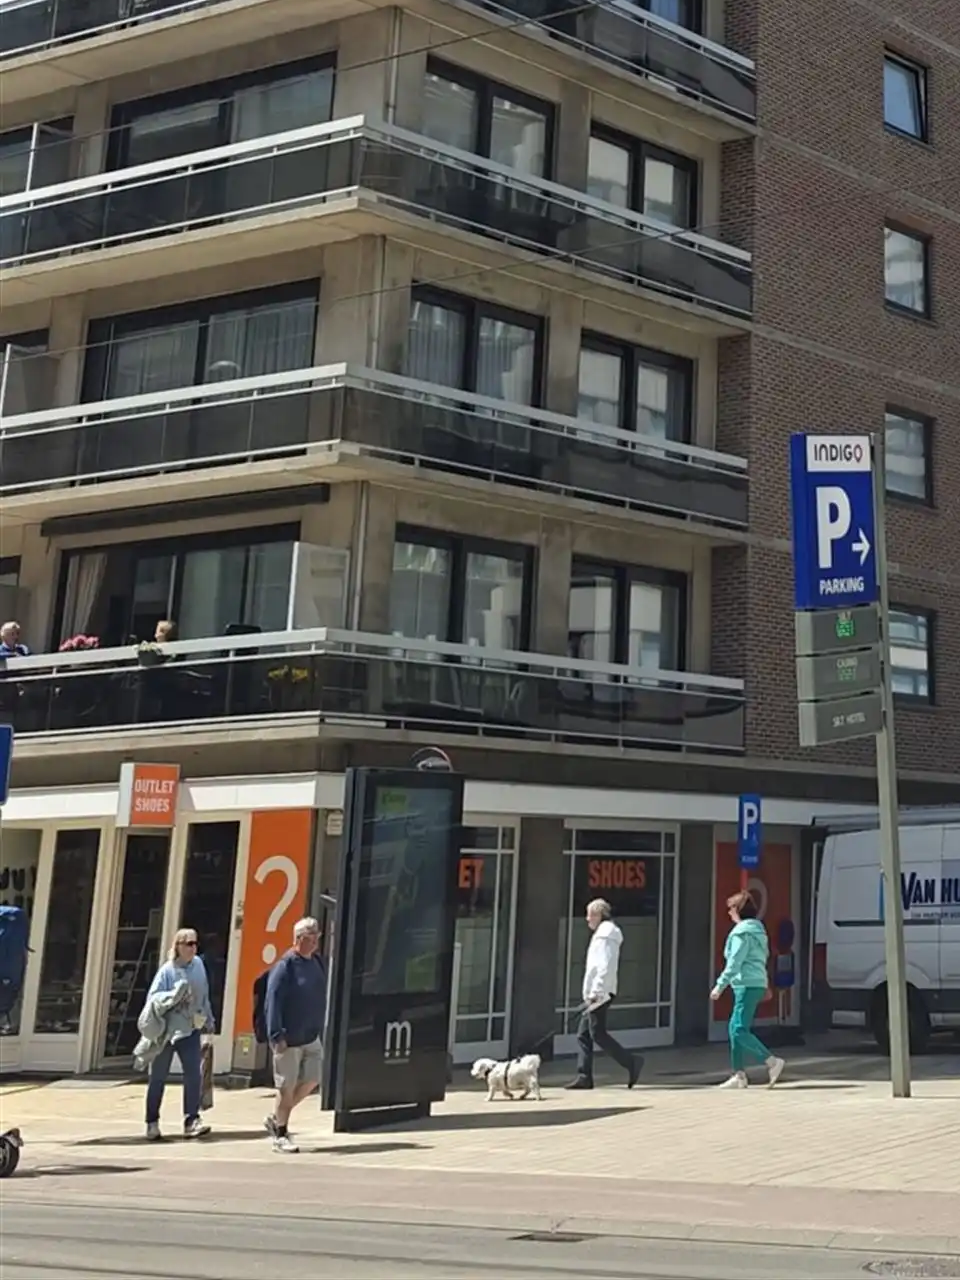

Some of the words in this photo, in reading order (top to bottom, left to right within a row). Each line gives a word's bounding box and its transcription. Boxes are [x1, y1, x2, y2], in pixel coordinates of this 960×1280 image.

[814, 443, 863, 463] INDIGO
[816, 486, 851, 568] P
[819, 576, 864, 595] PARKING
[135, 779, 176, 794] OUTLET
[135, 798, 170, 812] SHOES
[743, 802, 758, 840] P
[588, 859, 646, 888] SHOES
[900, 872, 936, 911] VAN
